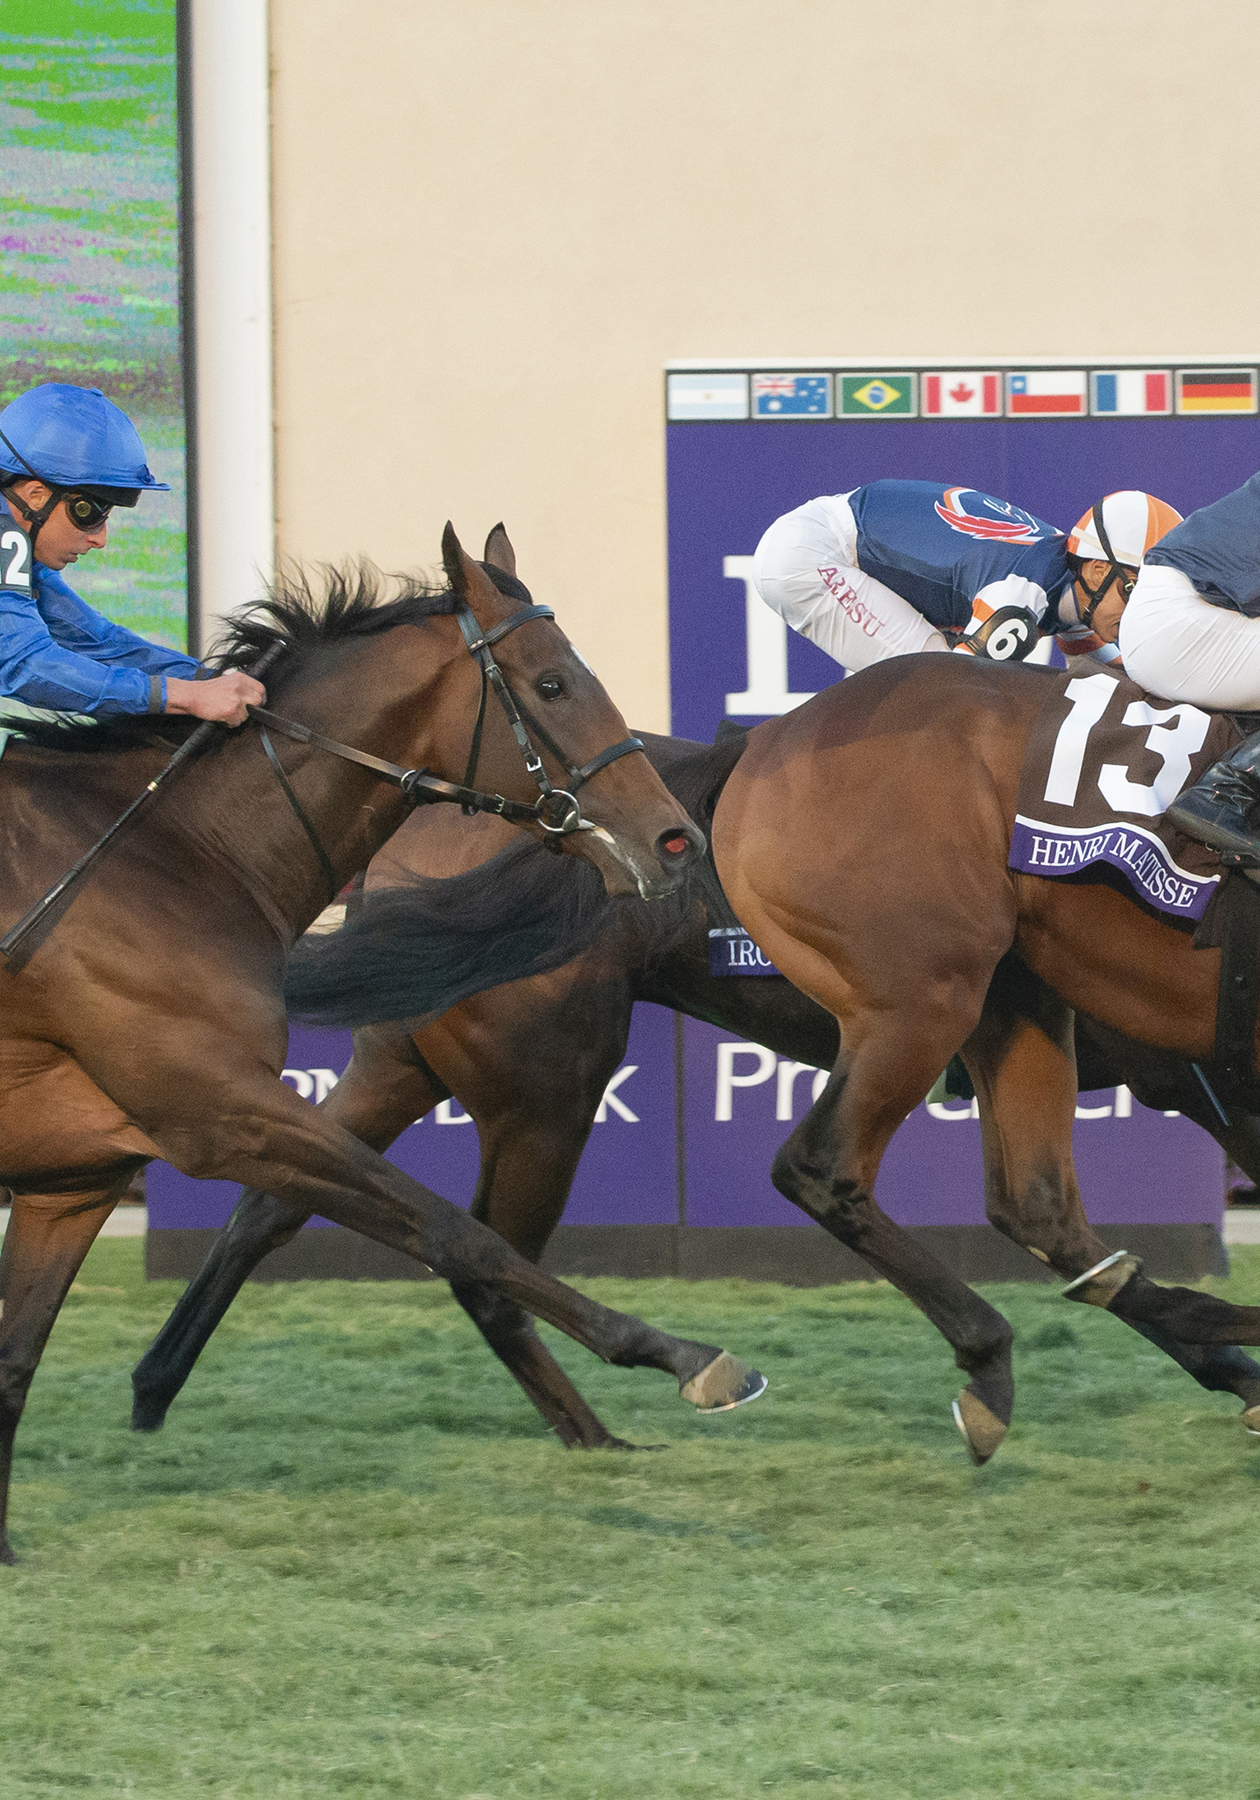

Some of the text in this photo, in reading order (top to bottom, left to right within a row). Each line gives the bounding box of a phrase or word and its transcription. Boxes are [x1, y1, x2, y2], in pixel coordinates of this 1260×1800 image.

[0, 531, 30, 587] 2
[986, 618, 1028, 661] 6
[1043, 672, 1212, 817] 13
[1028, 832, 1198, 908] HENRI MATISSE
